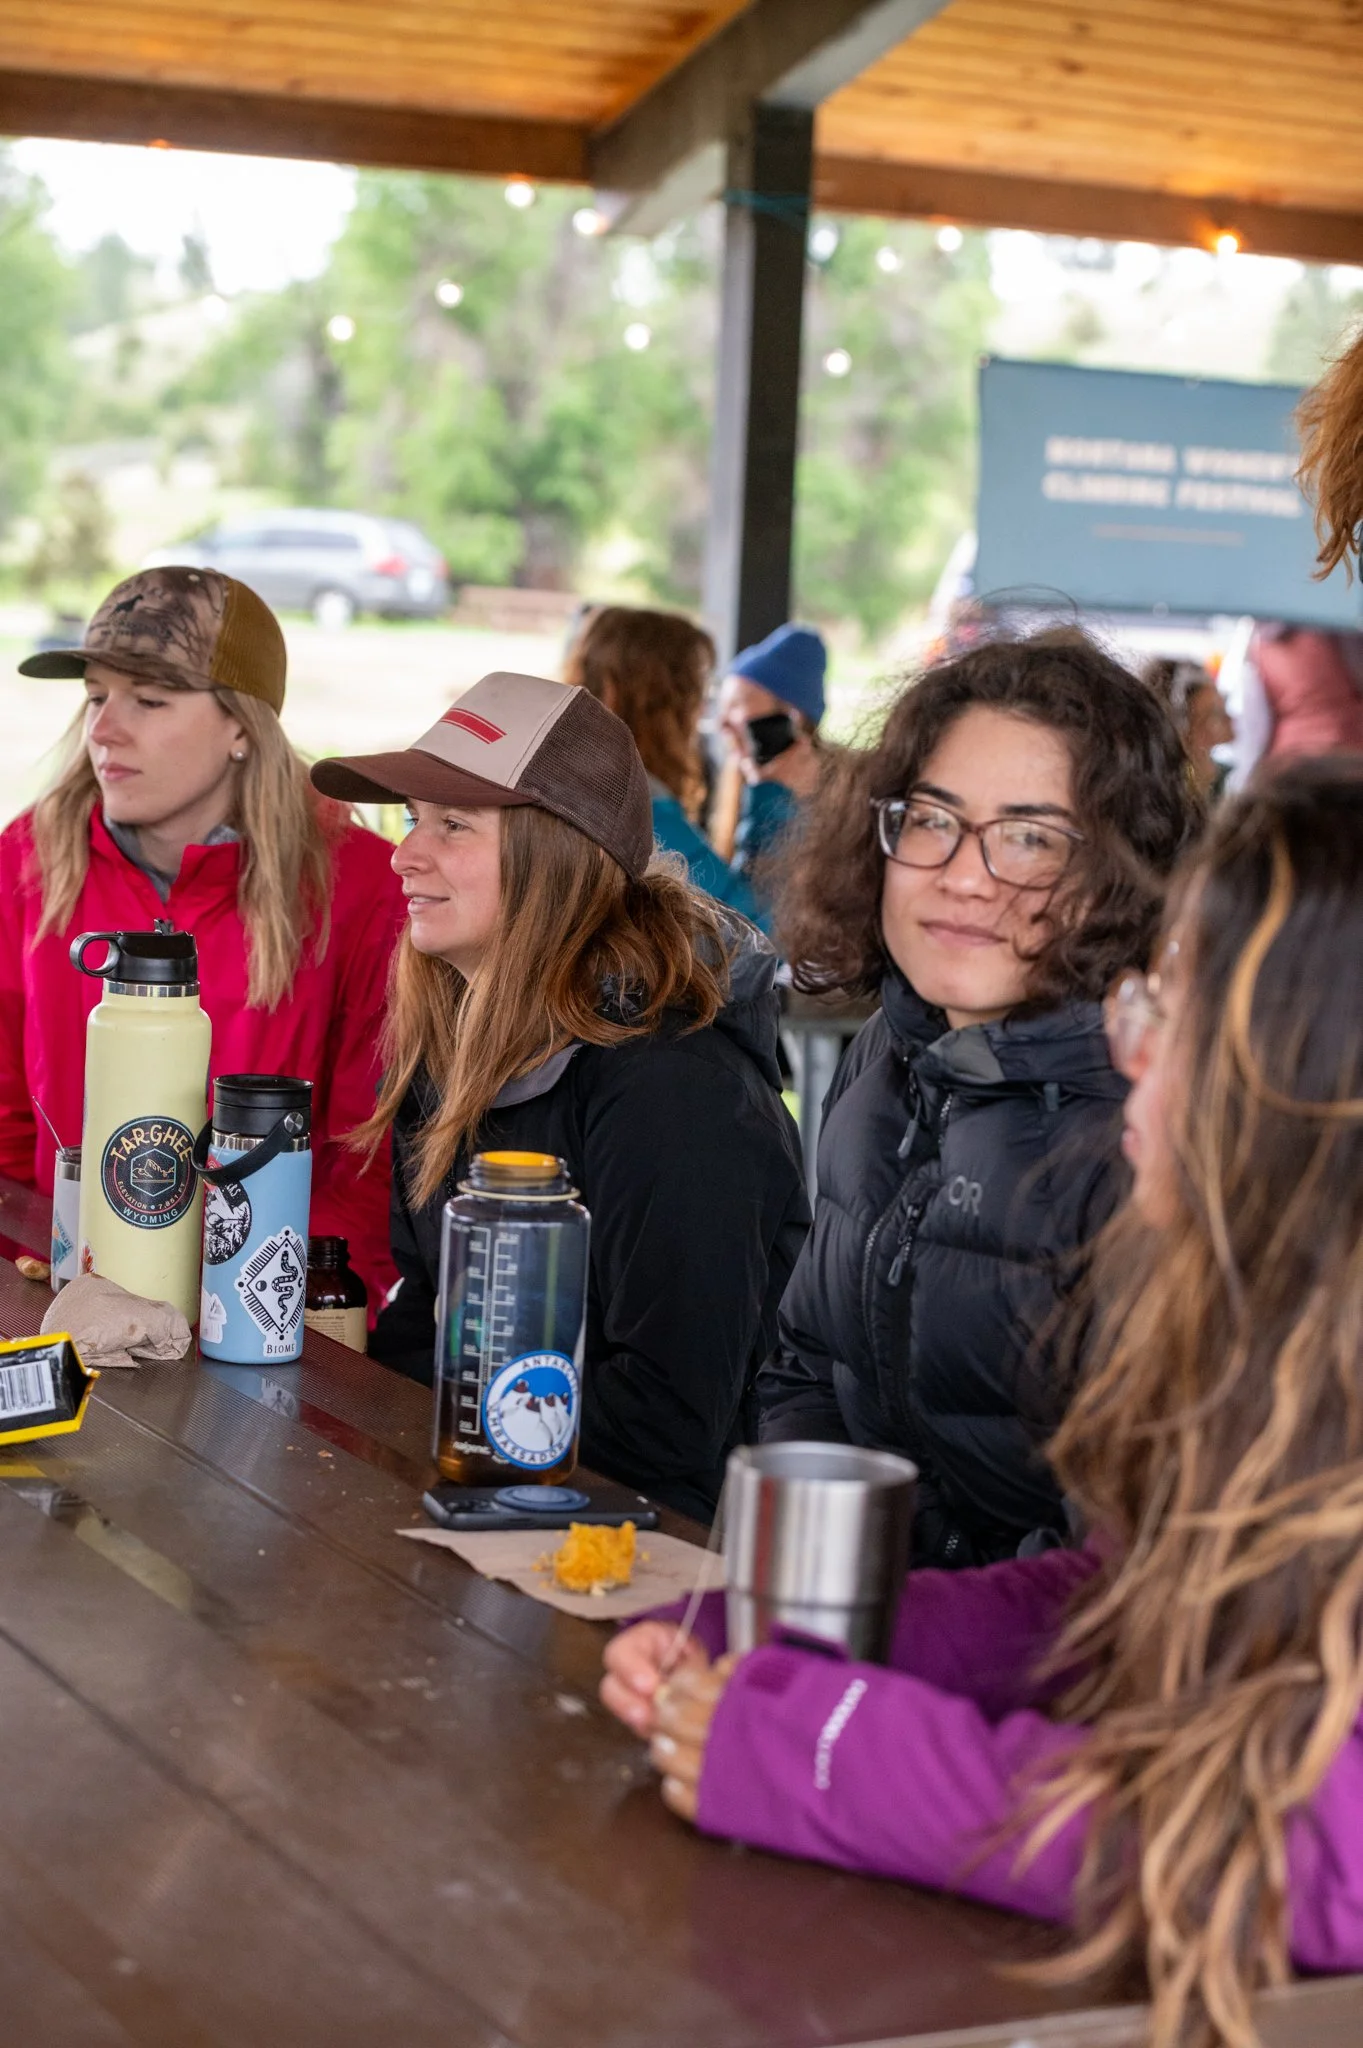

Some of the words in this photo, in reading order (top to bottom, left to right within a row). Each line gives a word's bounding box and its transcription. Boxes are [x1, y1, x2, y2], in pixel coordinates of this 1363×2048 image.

[110, 1124, 193, 1162] TARGHEE
[117, 1180, 148, 1210] ELEVATION
[949, 1175, 982, 1215] OR
[122, 1206, 179, 1224] WYOMING
[266, 1343, 295, 1354] BIOME
